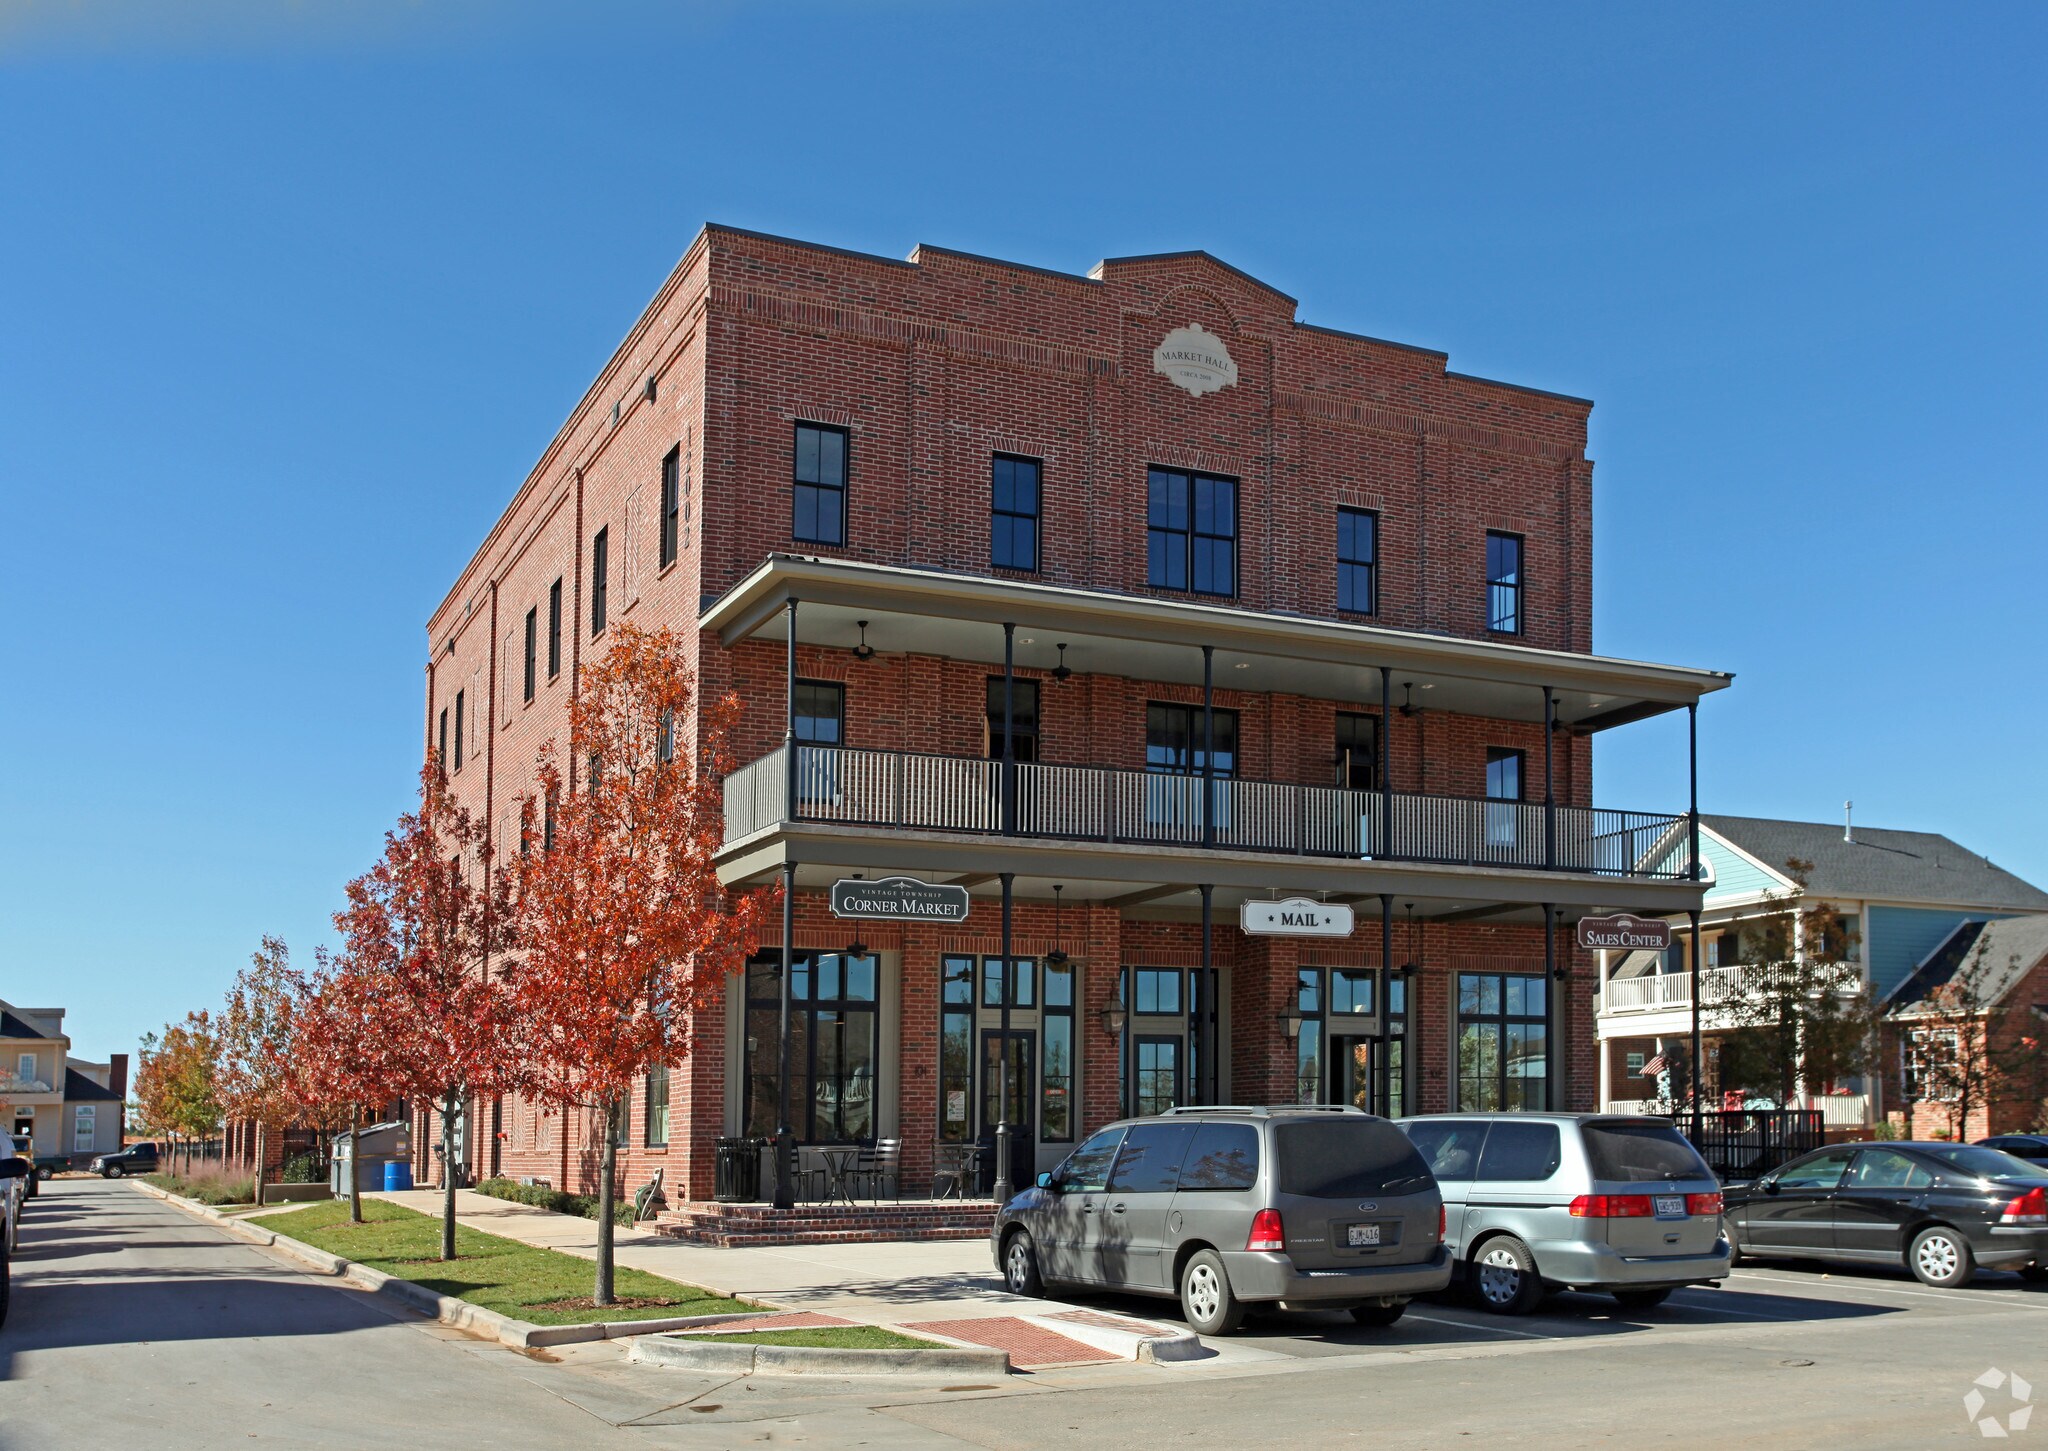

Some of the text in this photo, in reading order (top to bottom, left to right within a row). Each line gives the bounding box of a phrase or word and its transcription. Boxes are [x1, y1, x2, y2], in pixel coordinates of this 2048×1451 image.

[1162, 351, 1230, 371] MARKET HALL
[1180, 370, 1198, 378] CIRCA
[862, 888, 942, 899] VINTAGE TOWNSHIP
[843, 896, 960, 916] CORNER MARKET
[1281, 913, 1319, 927] MAIL
[1587, 931, 1663, 946] SALES CENTER
